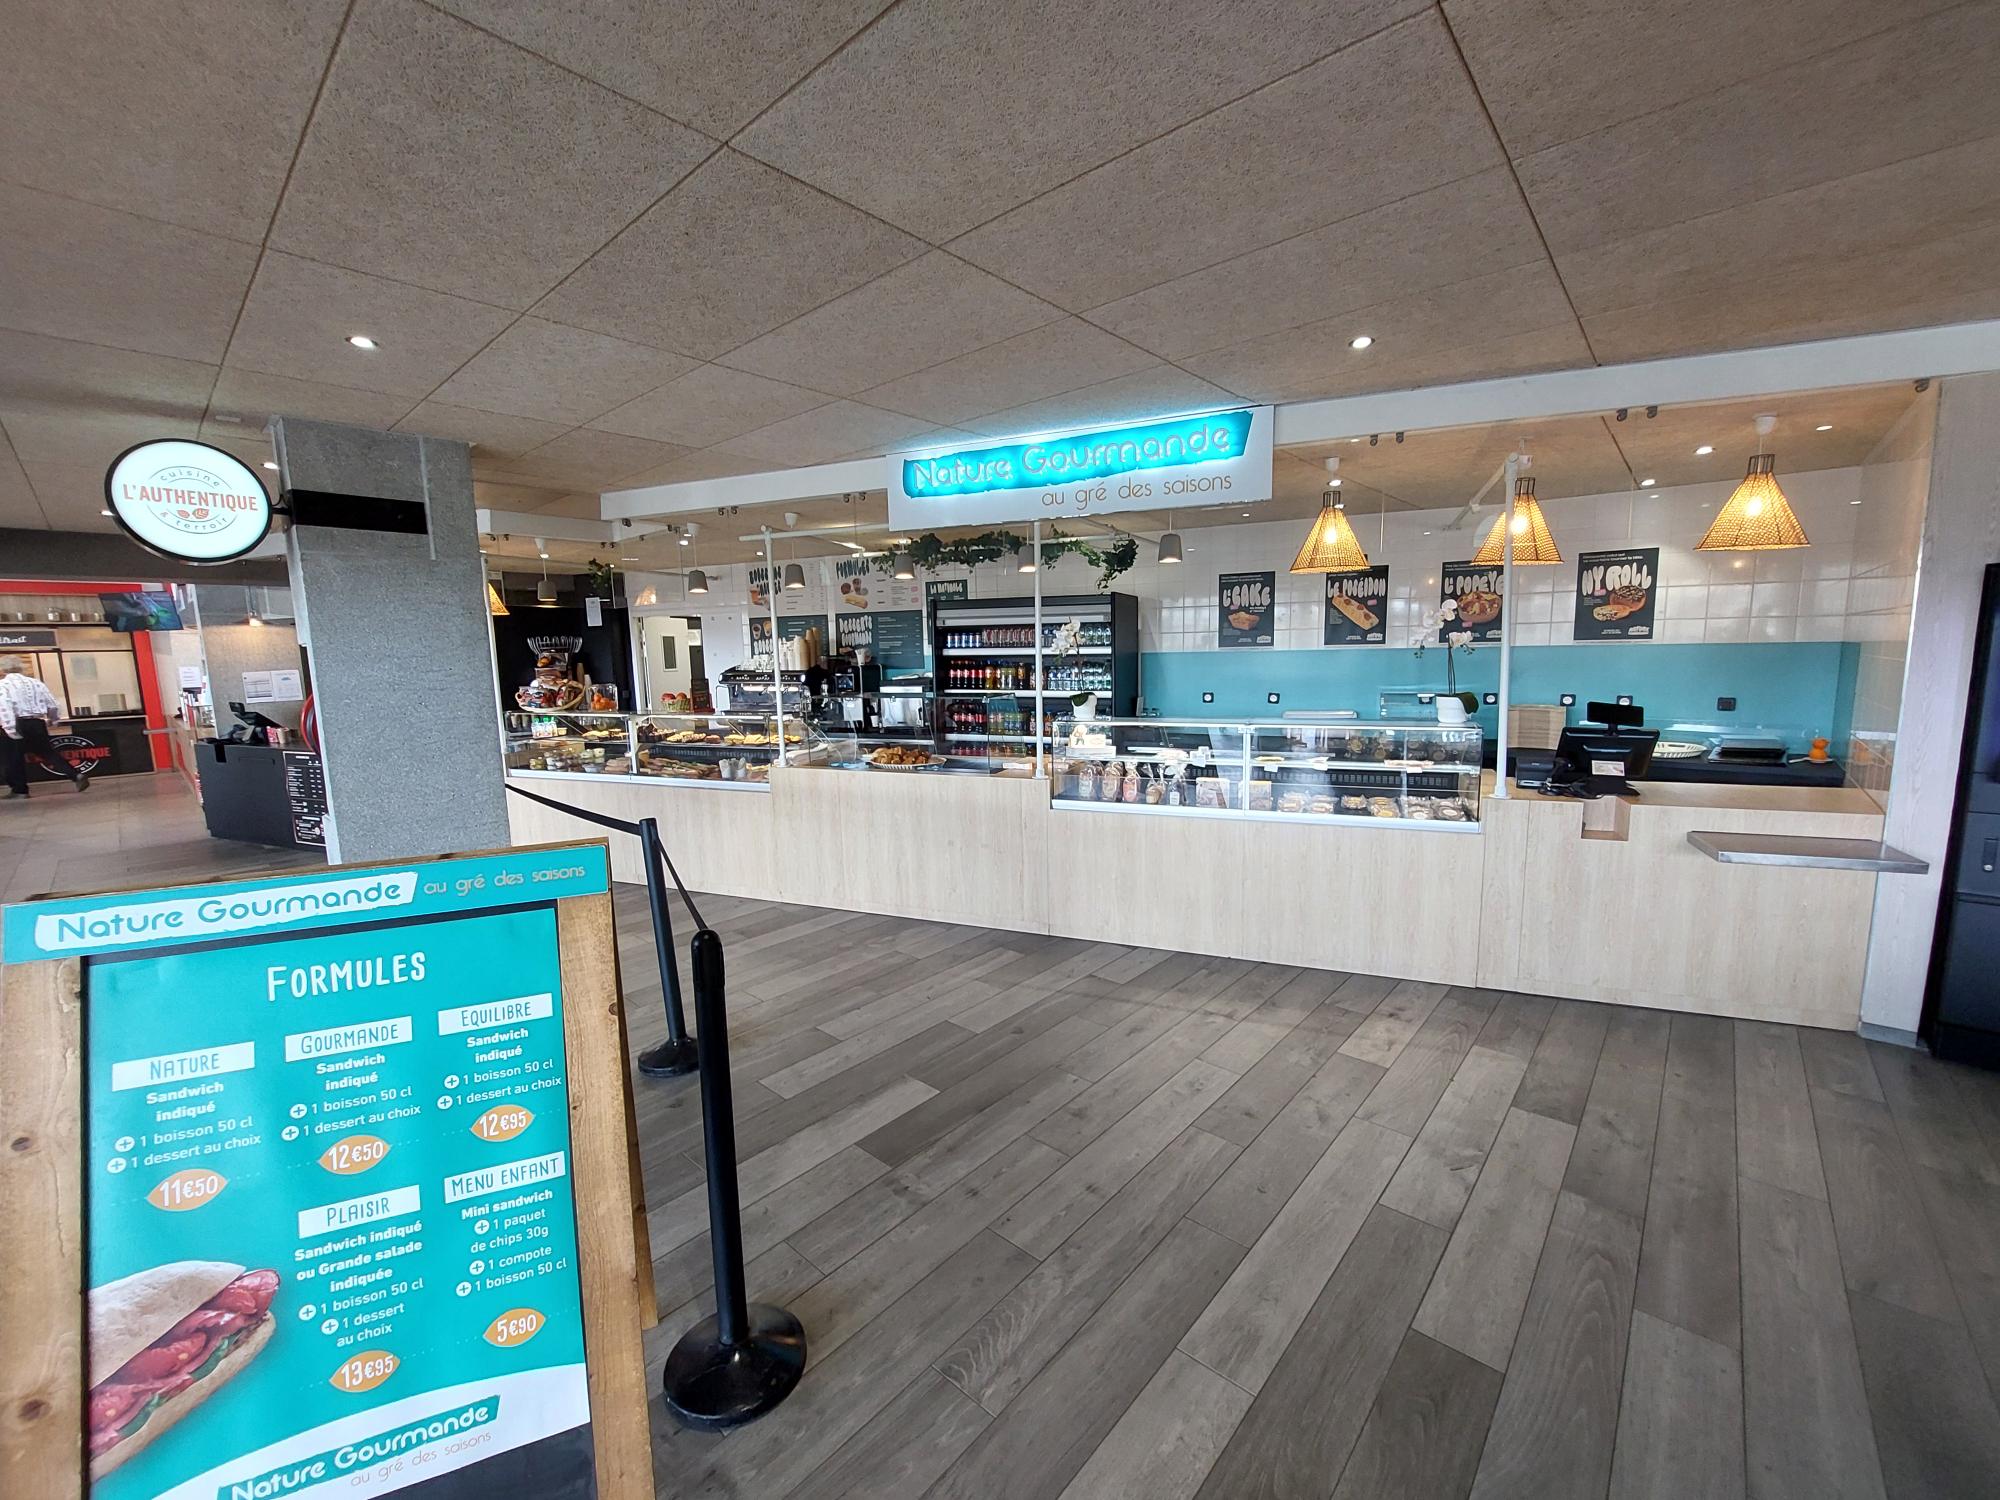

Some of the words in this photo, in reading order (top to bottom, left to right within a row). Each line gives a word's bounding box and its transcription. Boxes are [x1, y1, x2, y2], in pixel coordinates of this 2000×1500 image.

[913, 457, 1010, 489] Nature
[1022, 424, 1229, 472] Gourmande
[160, 469, 220, 487] cuisine
[1041, 490, 1065, 506] au
[1075, 480, 1107, 511] gré
[1118, 477, 1153, 499] des
[1163, 474, 1232, 496] saisons
[123, 484, 258, 512] L'AUTHENTIQUE
[176, 517, 227, 531] terroir
[1582, 566, 1604, 596] NY
[1606, 562, 1651, 591] ROLL
[58, 910, 184, 942] Nature
[198, 882, 401, 923] Gourmande
[424, 882, 447, 896] au
[456, 875, 486, 896] gré
[494, 870, 524, 887] des
[533, 864, 585, 882] saisons
[267, 951, 426, 1001] FORMULES
[461, 1002, 532, 1027] EQUILIBRE
[301, 1024, 399, 1054] GOURMANDE
[467, 1028, 529, 1047] Sandwich
[150, 1053, 221, 1080] NATURE
[316, 1053, 385, 1074] Sandwich
[475, 1045, 523, 1064] indiqué
[325, 1072, 378, 1091] indiqué
[463, 1074, 469, 1085] 1
[474, 1066, 521, 1083] boisson
[524, 1061, 540, 1073] 50
[543, 1059, 553, 1070] cl
[146, 1082, 224, 1104] Sandwich
[312, 1103, 318, 1114] 1
[323, 1094, 376, 1112] boisson
[380, 1088, 396, 1101] 50
[400, 1086, 412, 1097] cl
[456, 1095, 462, 1105] 1
[467, 1085, 511, 1103] dessert
[514, 1083, 529, 1094] au
[531, 1076, 562, 1091] choix
[156, 1101, 216, 1122] indiqué
[303, 1125, 310, 1136] 1
[314, 1114, 365, 1134] dessert
[368, 1112, 385, 1124] au
[387, 1104, 421, 1120] choix
[479, 1111, 527, 1138] 12€95
[140, 1136, 147, 1147] 1
[154, 1125, 213, 1145] boisson
[218, 1119, 236, 1133] 50
[240, 1116, 254, 1128] cl
[131, 1157, 138, 1168] 1
[144, 1145, 201, 1166] dessert
[204, 1142, 221, 1154] au
[224, 1134, 262, 1150] choix
[328, 1141, 384, 1171] 12€50
[160, 1175, 219, 1207] 11€50
[452, 1172, 494, 1197] MENU
[501, 1157, 559, 1185] ENFANT
[327, 1197, 390, 1227] PLAISIR
[461, 1205, 489, 1220] Mini
[492, 1190, 553, 1212] sandwich
[493, 1219, 499, 1229] 1
[504, 1208, 546, 1228] paquet
[294, 1234, 366, 1261] Sandwich
[370, 1220, 422, 1243] indiqué
[471, 1241, 486, 1254] de
[489, 1231, 523, 1250] chips
[526, 1225, 549, 1240] 30g
[296, 1268, 315, 1281] ou
[318, 1253, 371, 1275] Grande
[375, 1241, 423, 1261] salade
[488, 1260, 494, 1270] 1
[499, 1246, 552, 1268] compote
[330, 1268, 393, 1292] indiquée
[475, 1281, 481, 1291] 1
[486, 1269, 535, 1289] boisson
[538, 1261, 553, 1275] 50
[556, 1257, 567, 1270] cl
[320, 1303, 327, 1315] 1
[333, 1290, 387, 1312] boisson
[391, 1281, 408, 1296] 50
[412, 1278, 424, 1290] cl
[342, 1317, 349, 1328] 1
[354, 1303, 404, 1326] dessert
[497, 1313, 537, 1343] 5€90
[336, 1334, 353, 1347] au
[357, 1323, 392, 1342] choix
[341, 1354, 394, 1388] 13€95
[231, 1462, 326, 1500] Nature
[334, 1407, 489, 1469] Gourmande
[351, 1473, 370, 1486] au
[378, 1457, 403, 1482] gré
[412, 1450, 437, 1466] des
[444, 1430, 491, 1455] saisons
